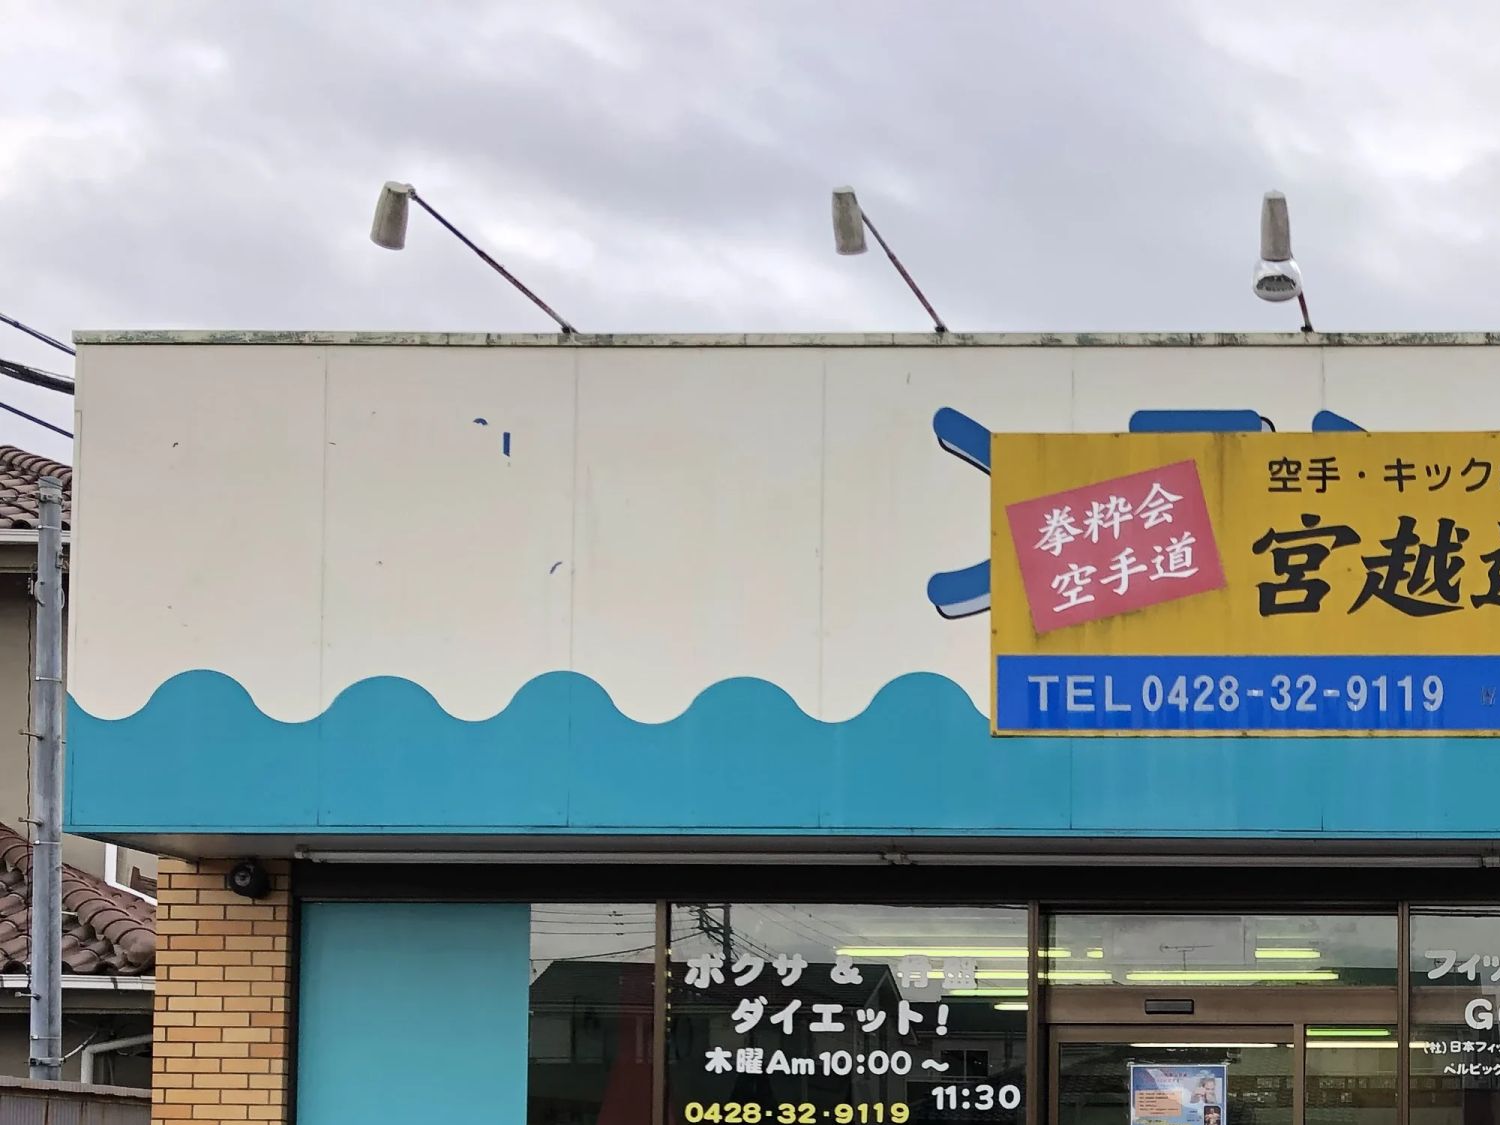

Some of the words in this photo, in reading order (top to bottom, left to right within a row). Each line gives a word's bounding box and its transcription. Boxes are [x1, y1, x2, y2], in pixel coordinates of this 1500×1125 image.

[1034, 482, 1185, 560] 拳粋会
[1049, 534, 1200, 613] 空手道
[1027, 675, 1131, 713] TEL
[1142, 674, 1445, 712] 0428-32-9119
[684, 952, 808, 989] ボクサ
[829, 955, 864, 986] &
[731, 995, 951, 1036] ダイエット!
[931, 1084, 1021, 1110] 11:30
